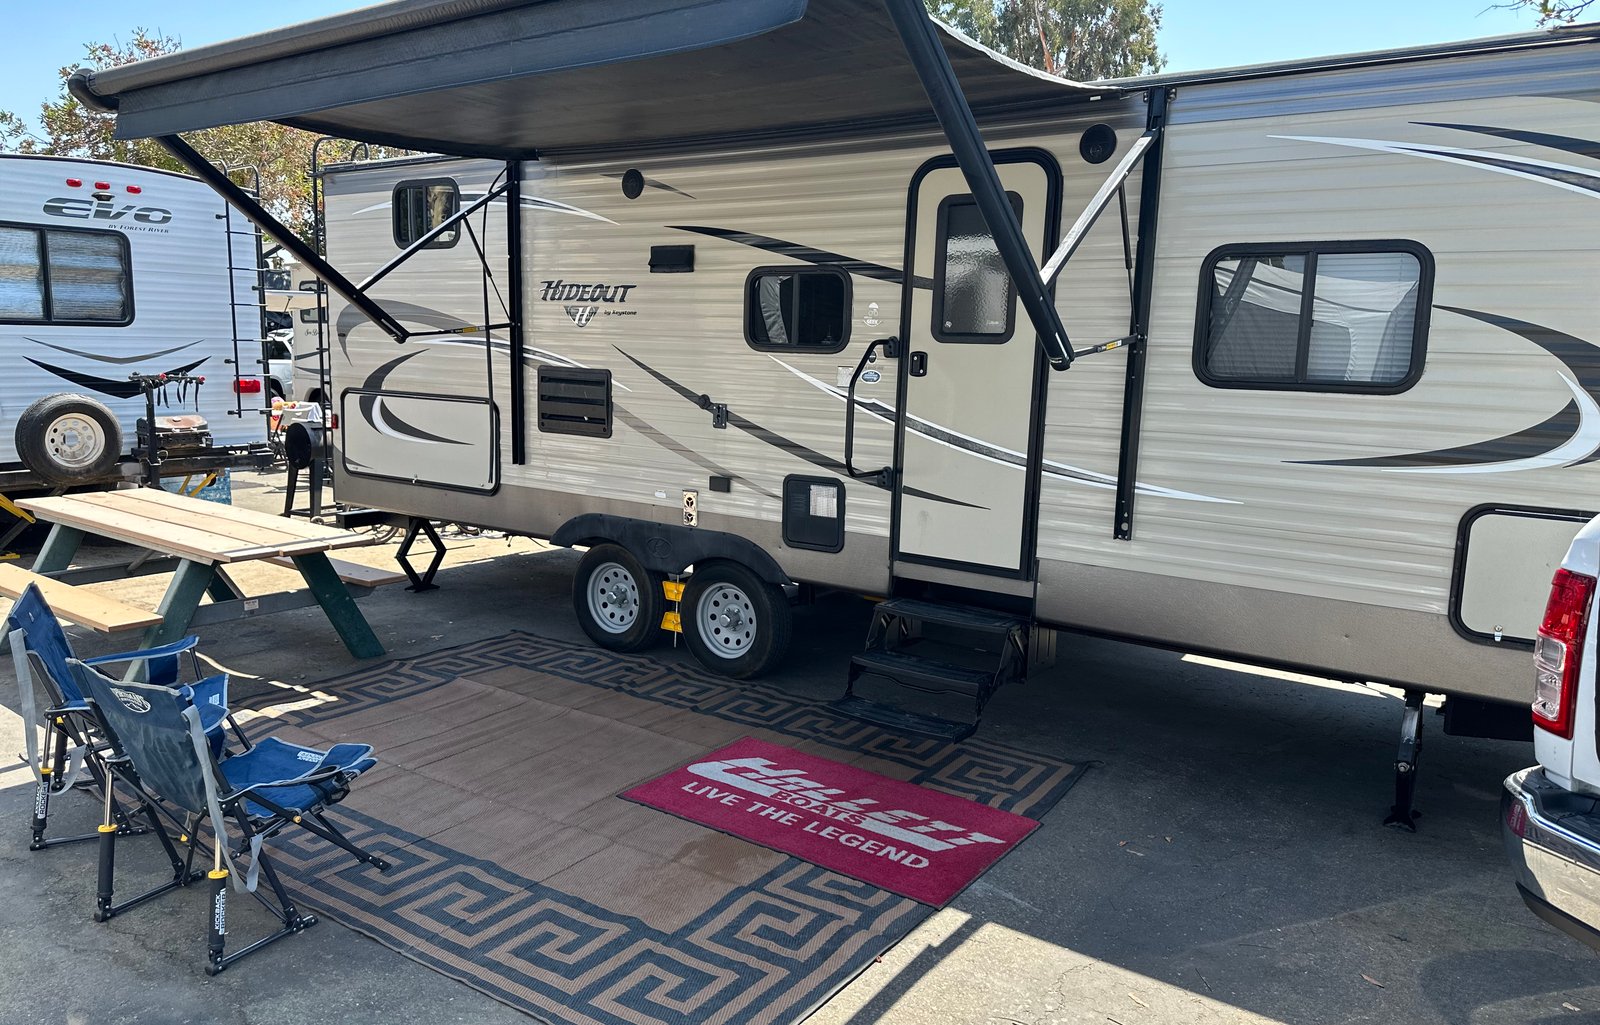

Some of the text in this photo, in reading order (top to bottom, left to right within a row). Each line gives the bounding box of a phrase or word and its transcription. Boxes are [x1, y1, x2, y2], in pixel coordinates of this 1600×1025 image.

[43, 197, 172, 224] EVO
[540, 280, 637, 302] HIDEOUT
[773, 790, 867, 826] BOATS
[681, 782, 930, 870] LIVE THE LEGEND
